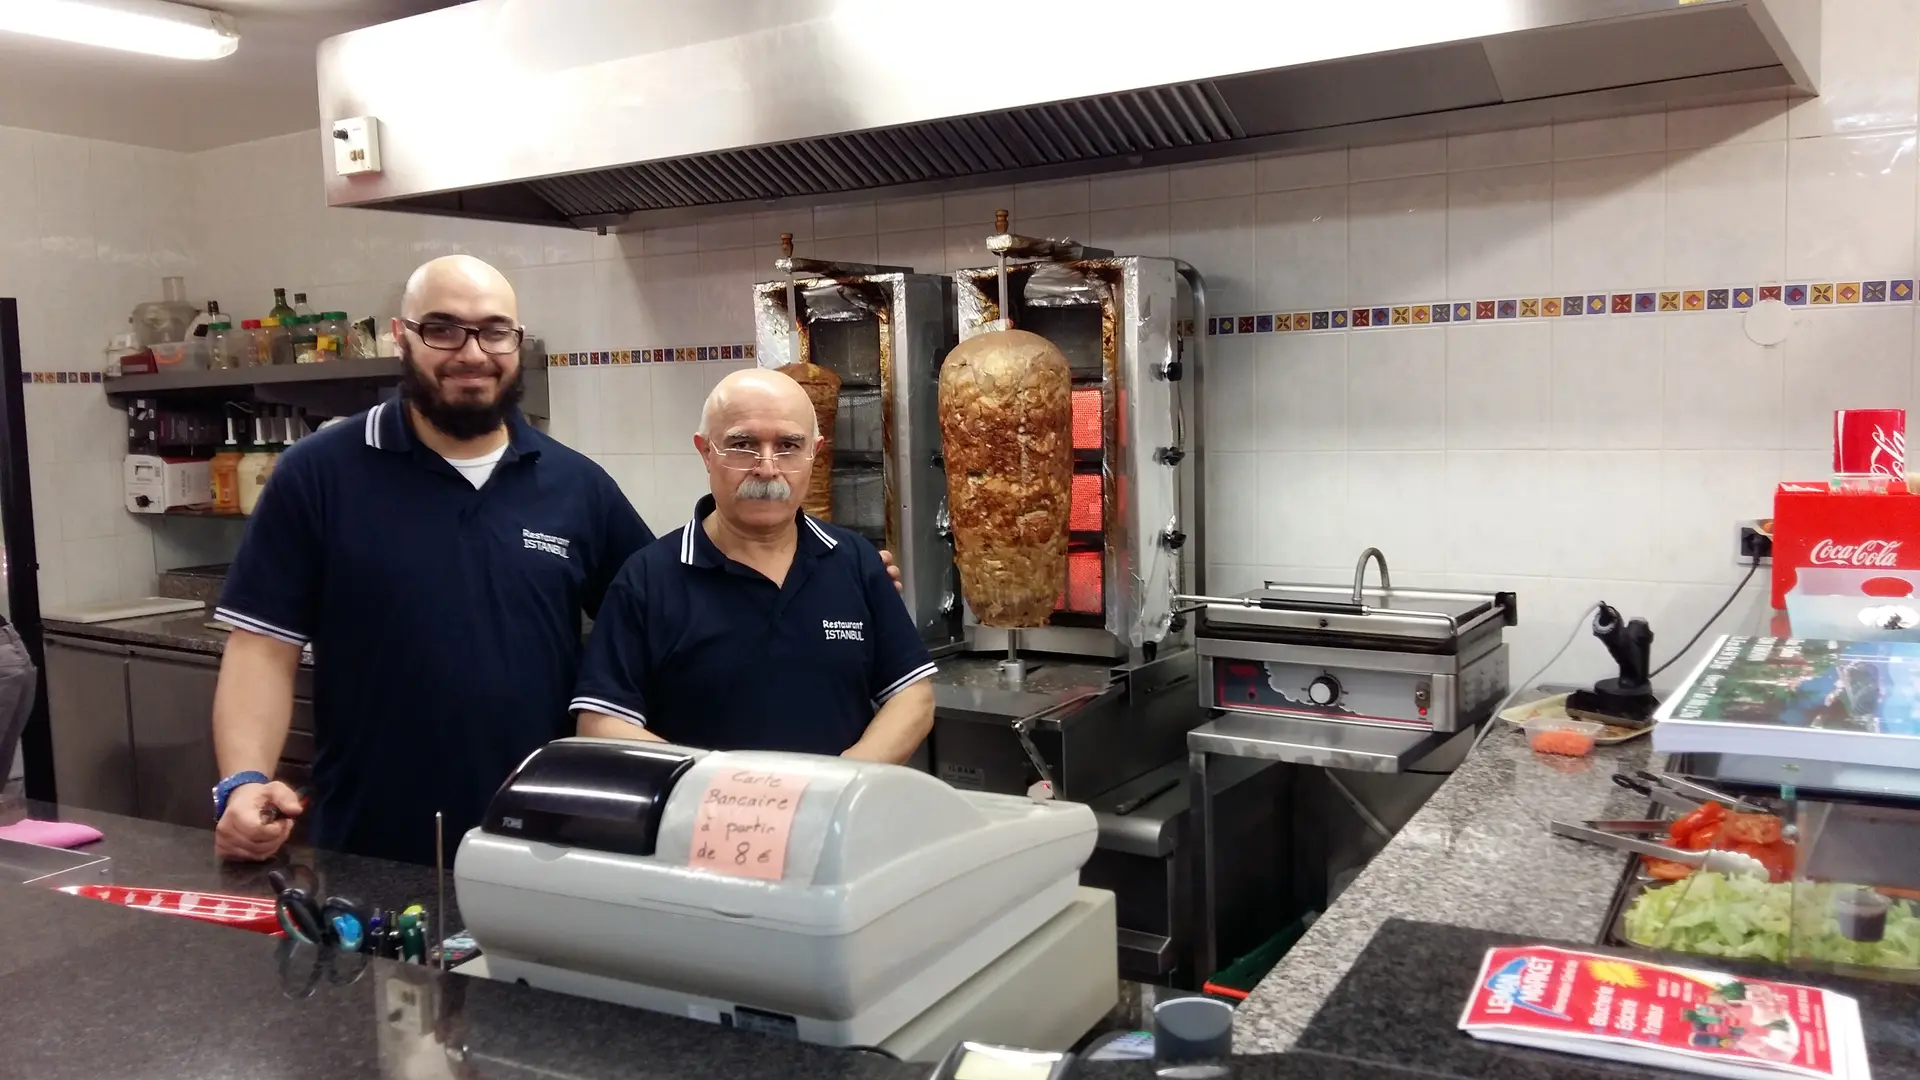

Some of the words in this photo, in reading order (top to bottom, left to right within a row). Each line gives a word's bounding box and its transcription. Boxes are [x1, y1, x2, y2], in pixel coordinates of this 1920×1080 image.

[523, 529, 570, 547] Restaurant
[523, 539, 570, 558] ISTANBUL
[1810, 539, 1902, 567] Coca-Cola
[822, 619, 863, 630] Restaurant
[825, 629, 865, 641] ISTANBUL
[732, 771, 782, 788] Carte
[704, 788, 788, 811] Bancaire
[701, 815, 716, 832] à
[725, 816, 775, 841] partir
[697, 841, 716, 860] de
